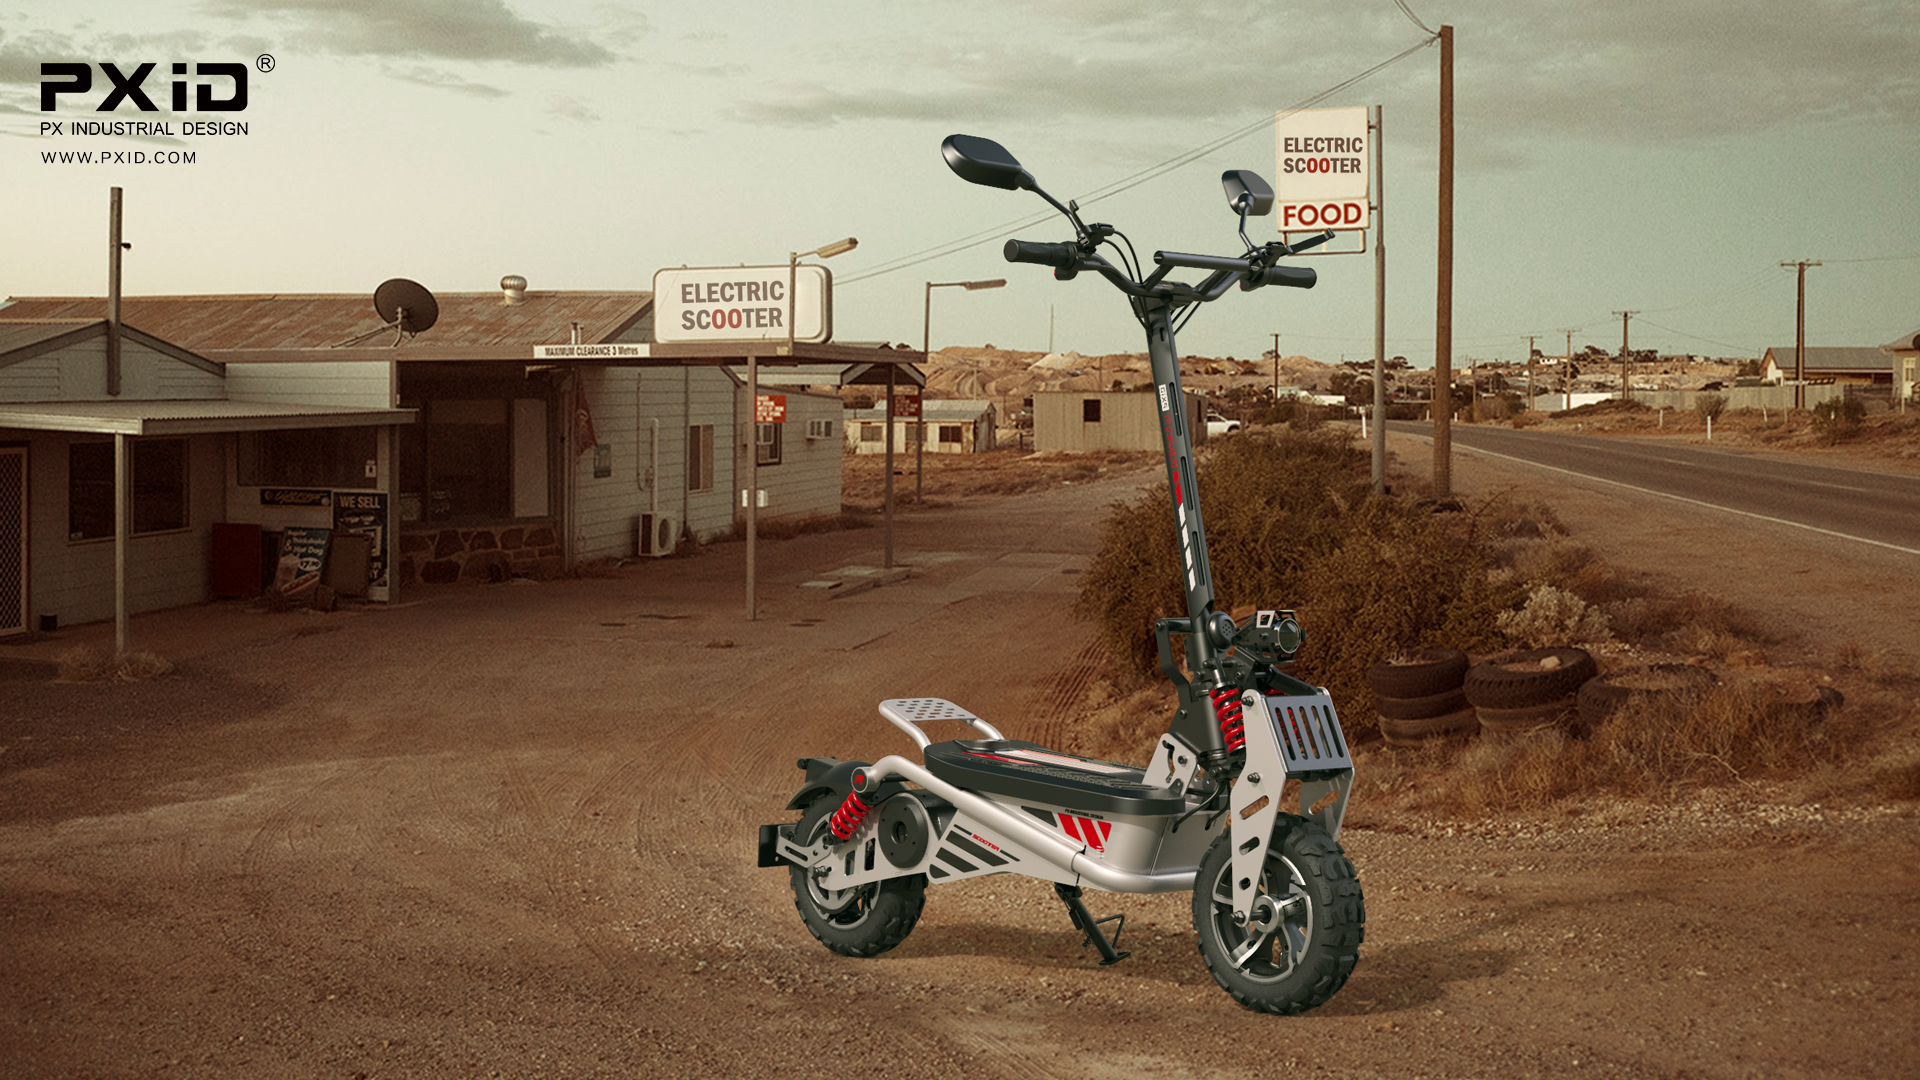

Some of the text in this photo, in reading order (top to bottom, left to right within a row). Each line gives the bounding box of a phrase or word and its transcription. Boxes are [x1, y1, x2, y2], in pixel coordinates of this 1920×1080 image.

[1283, 137, 1364, 153] ELECTRIC
[1283, 157, 1362, 174] SCOOTER
[1283, 202, 1362, 227] FOOD
[681, 280, 785, 304] ELECTRIC
[681, 307, 783, 331] SCOOTER
[544, 346, 575, 356] MAXIMUM
[576, 345, 611, 356] CLEARANCE
[340, 496, 356, 508] WE
[357, 496, 381, 509] SELL
[971, 833, 1000, 852] SCOOTER
